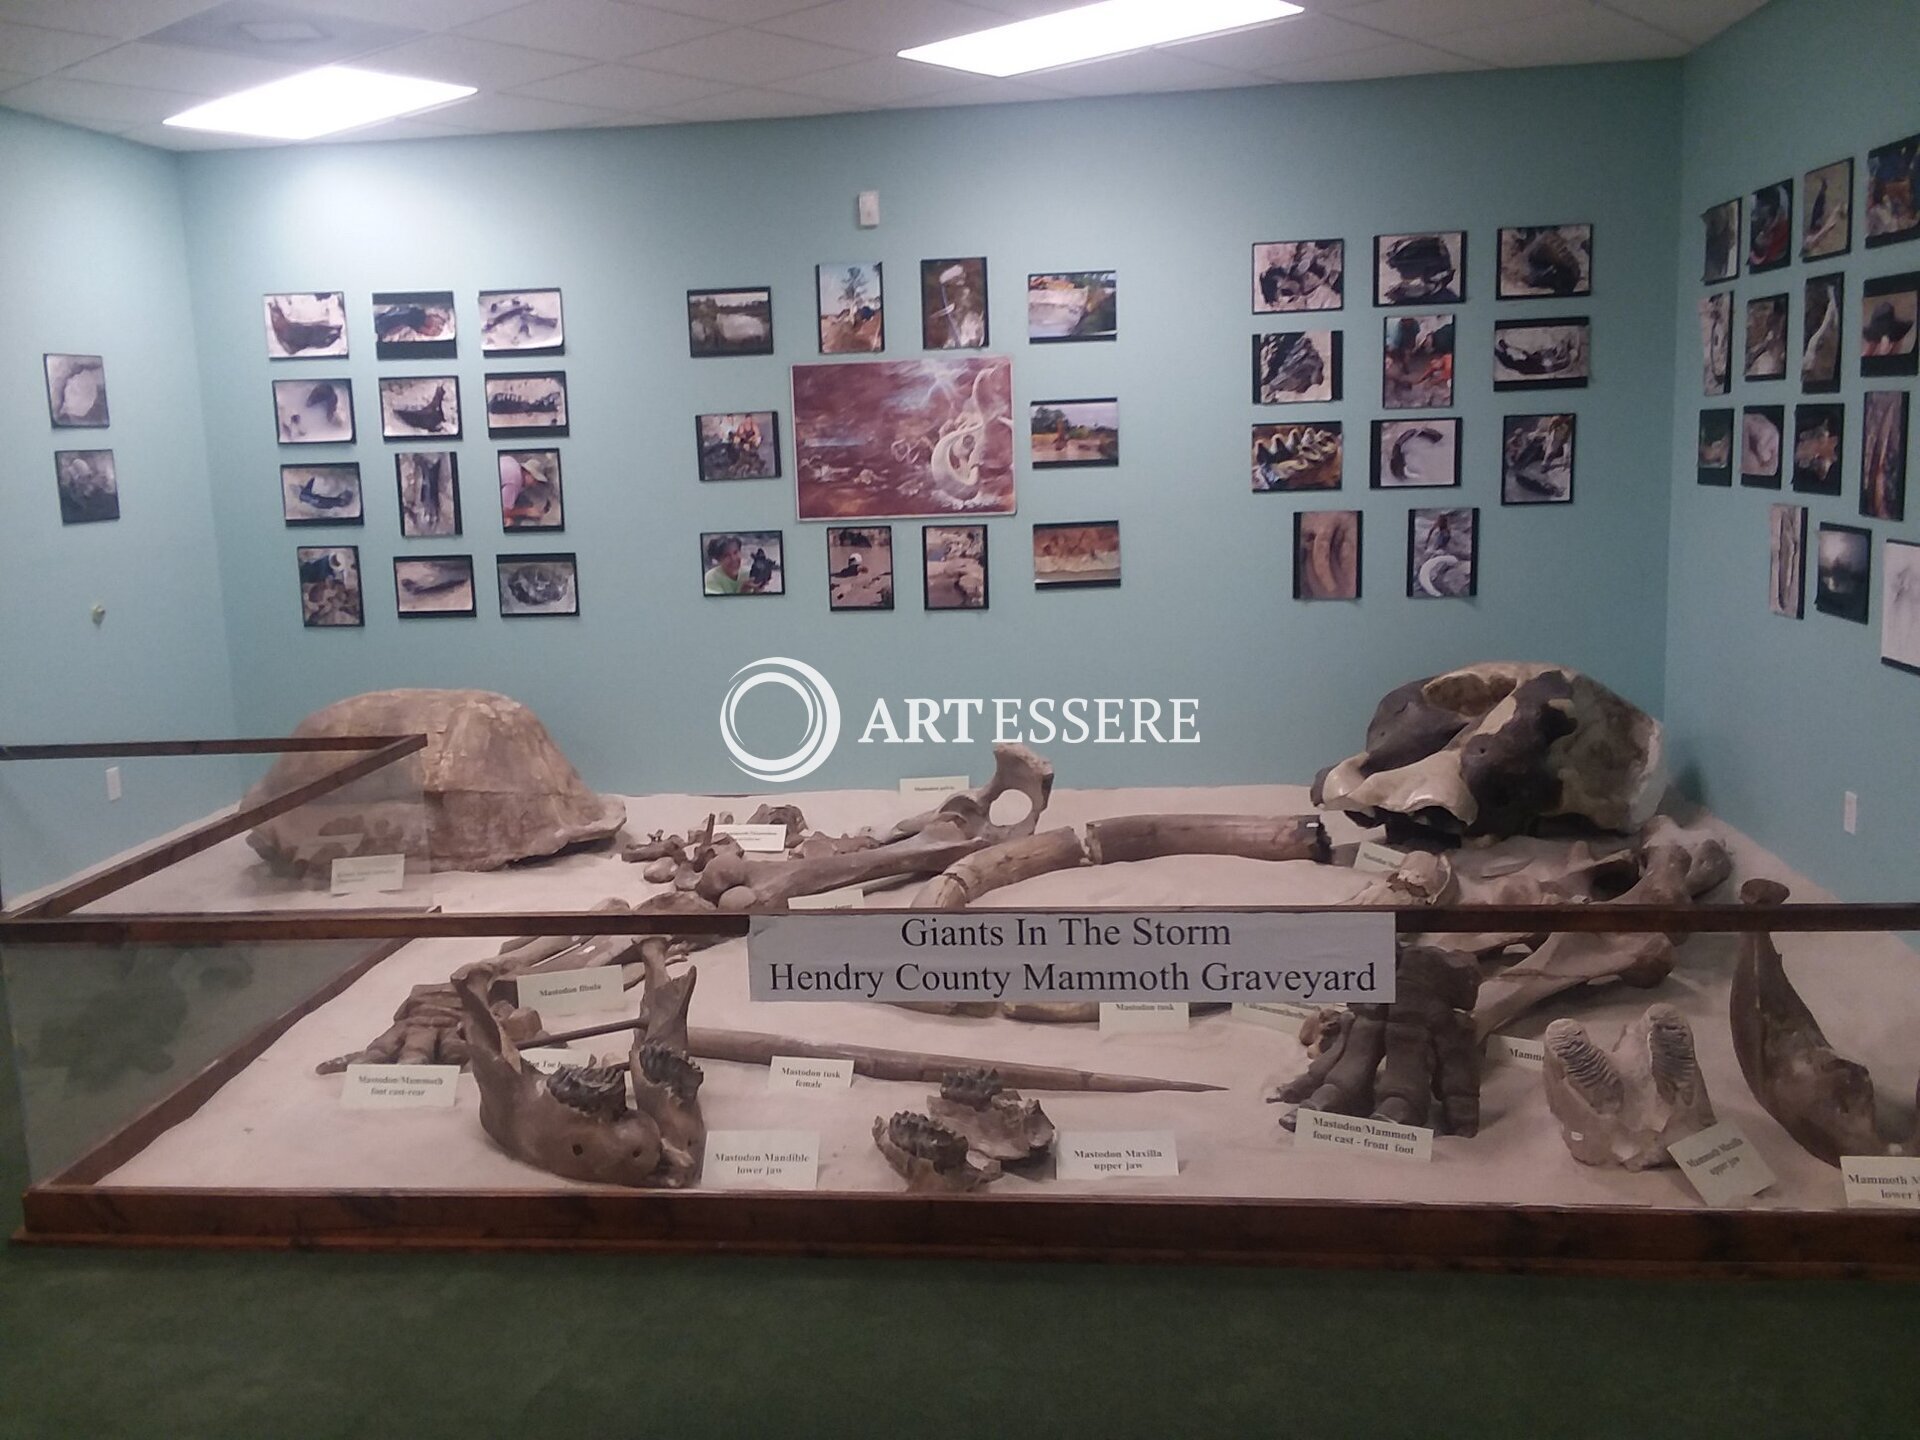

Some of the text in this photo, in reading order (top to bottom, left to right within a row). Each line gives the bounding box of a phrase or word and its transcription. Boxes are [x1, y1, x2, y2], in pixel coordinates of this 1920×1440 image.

[901, 916, 1231, 947] Giants In The Storm
[769, 961, 1377, 999] Hendry County Mammoth Graveyard
[782, 1067, 841, 1079] Mastodon tusk
[795, 1079, 823, 1089] female
[1312, 1130, 1333, 1142] foot
[1334, 1135, 1355, 1145] cast
[1363, 1138, 1389, 1151] front
[1394, 1144, 1415, 1155] foot
[715, 1153, 809, 1162] Mastodon Mandible
[1074, 1149, 1163, 1159] Mastodon Maxilla
[736, 1166, 783, 1176] lower jaw
[1093, 1161, 1143, 1172] upper jaw
[1848, 1173, 1908, 1185] Mammoth
[1880, 1188, 1912, 1200] lower
